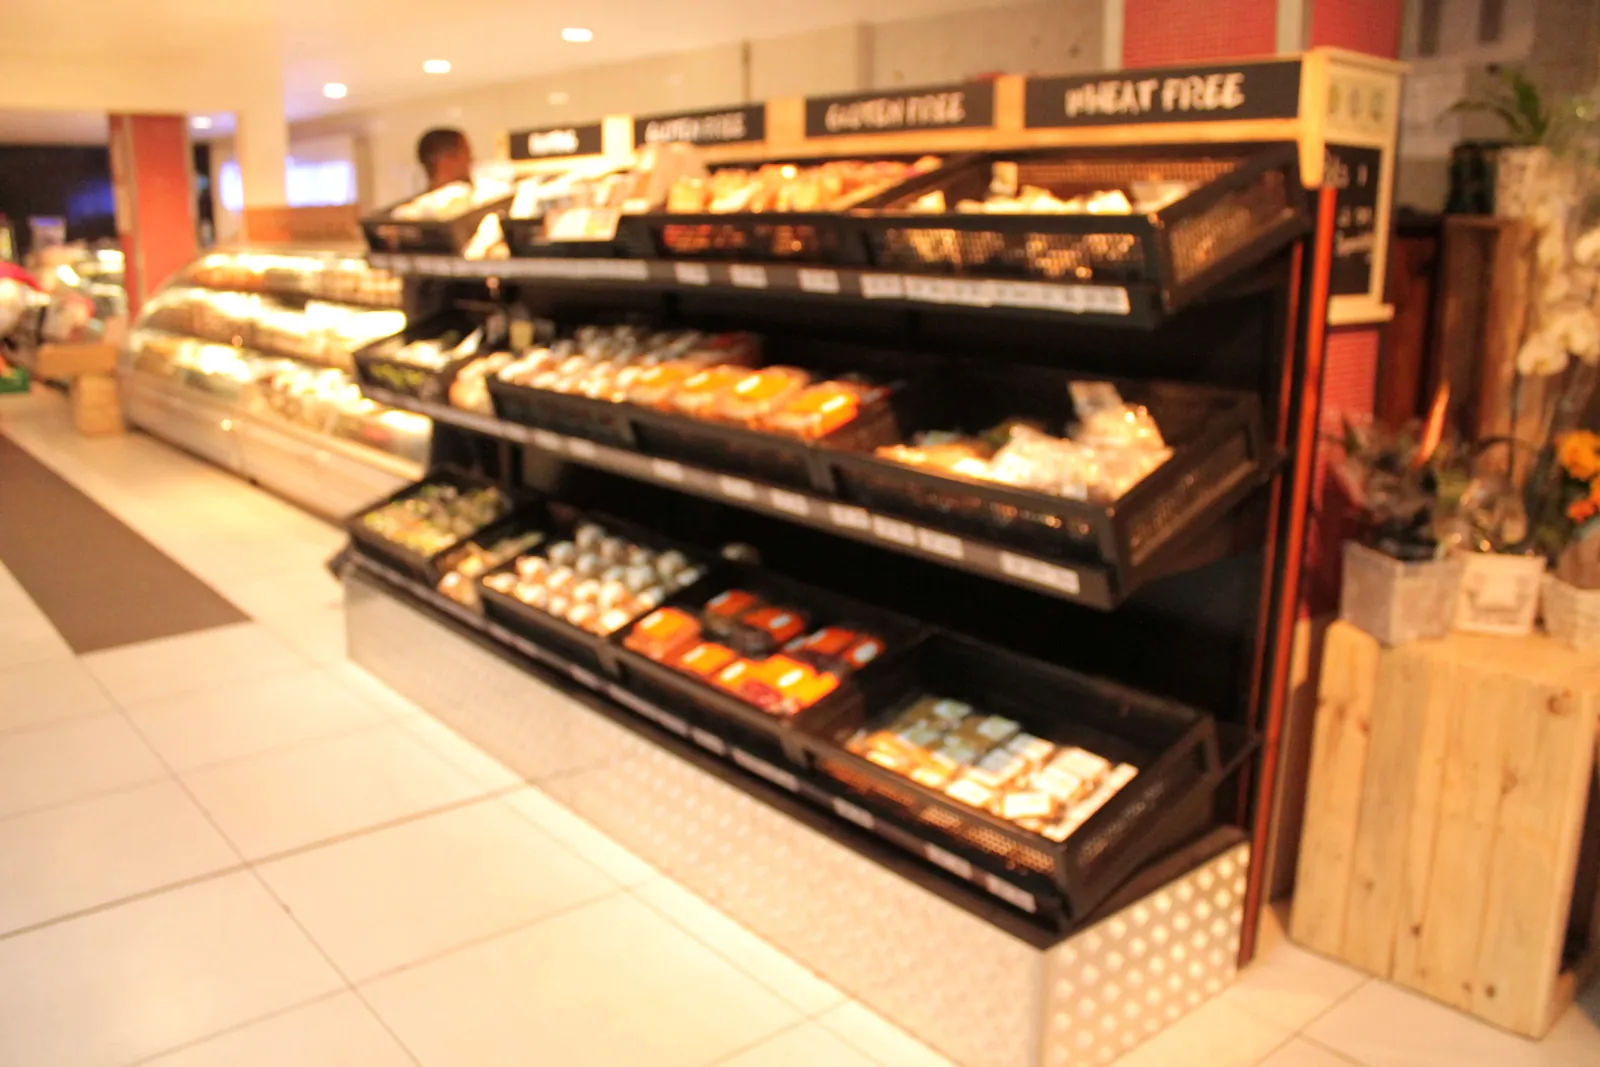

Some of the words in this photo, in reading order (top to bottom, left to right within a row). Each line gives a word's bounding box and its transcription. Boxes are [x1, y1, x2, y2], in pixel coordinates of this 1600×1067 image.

[825, 97, 904, 132] GLUTEN
[906, 91, 966, 126] FREE
[1064, 78, 1159, 118] WHEAT
[1161, 72, 1246, 112] FREE
